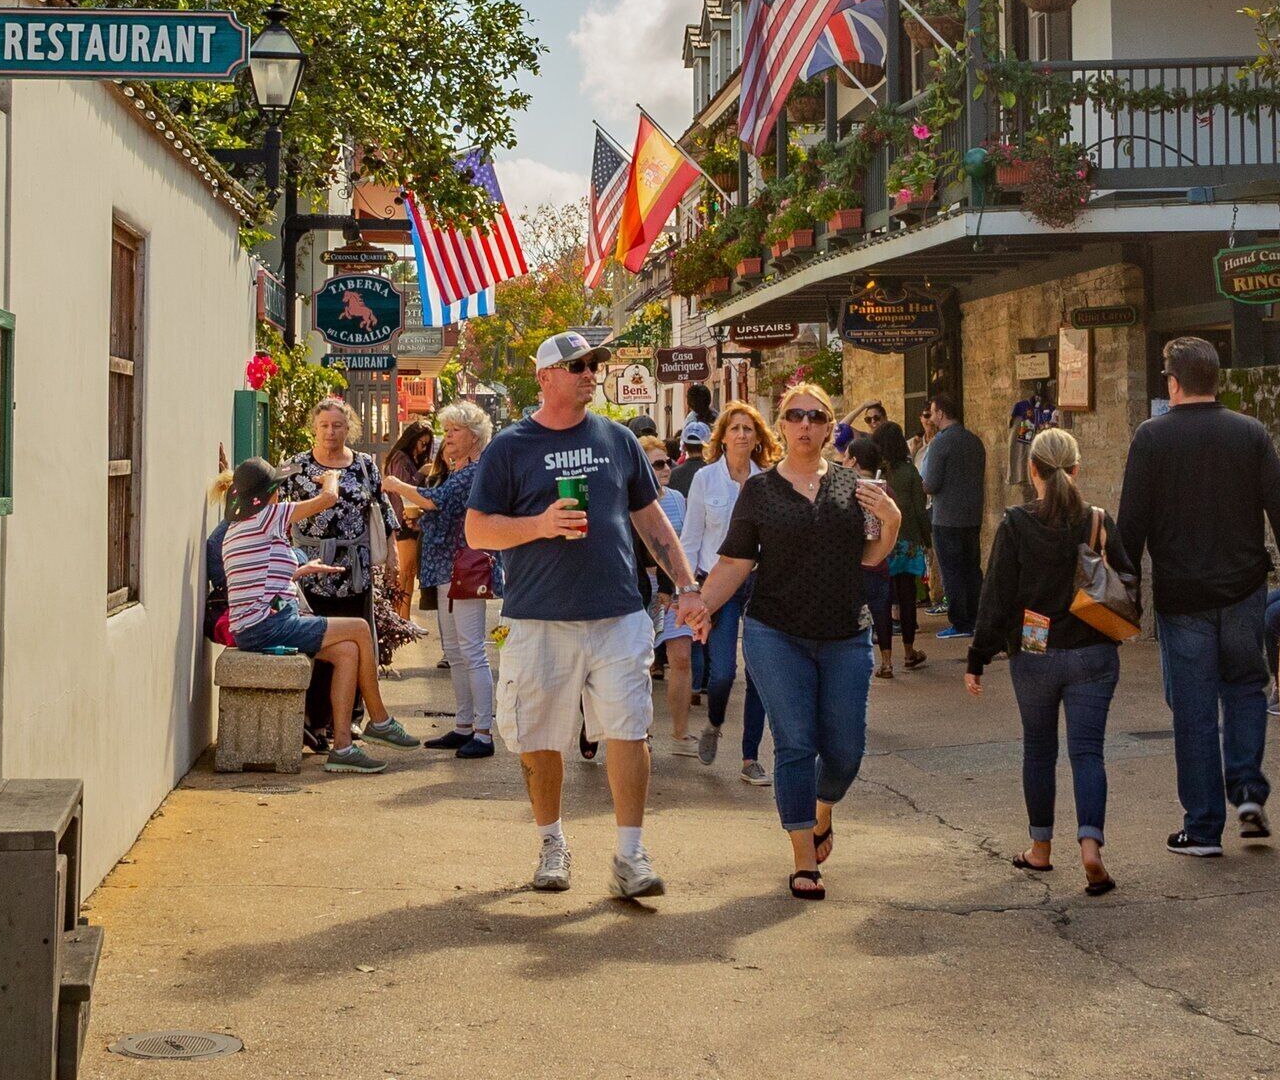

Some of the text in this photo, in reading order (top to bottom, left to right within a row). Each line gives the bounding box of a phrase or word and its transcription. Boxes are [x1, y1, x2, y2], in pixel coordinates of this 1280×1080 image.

[3, 22, 217, 64] RESTAURANT
[1224, 251, 1256, 271] Hand
[328, 279, 389, 297] TABERNA
[849, 303, 936, 314] Panama Hat
[866, 313, 917, 322] Company
[327, 328, 338, 337] DEL
[340, 325, 391, 342] CABALLO
[737, 323, 792, 333] UPSTAIRS
[672, 351, 693, 361] Casa
[544, 447, 610, 471] SHHH...
